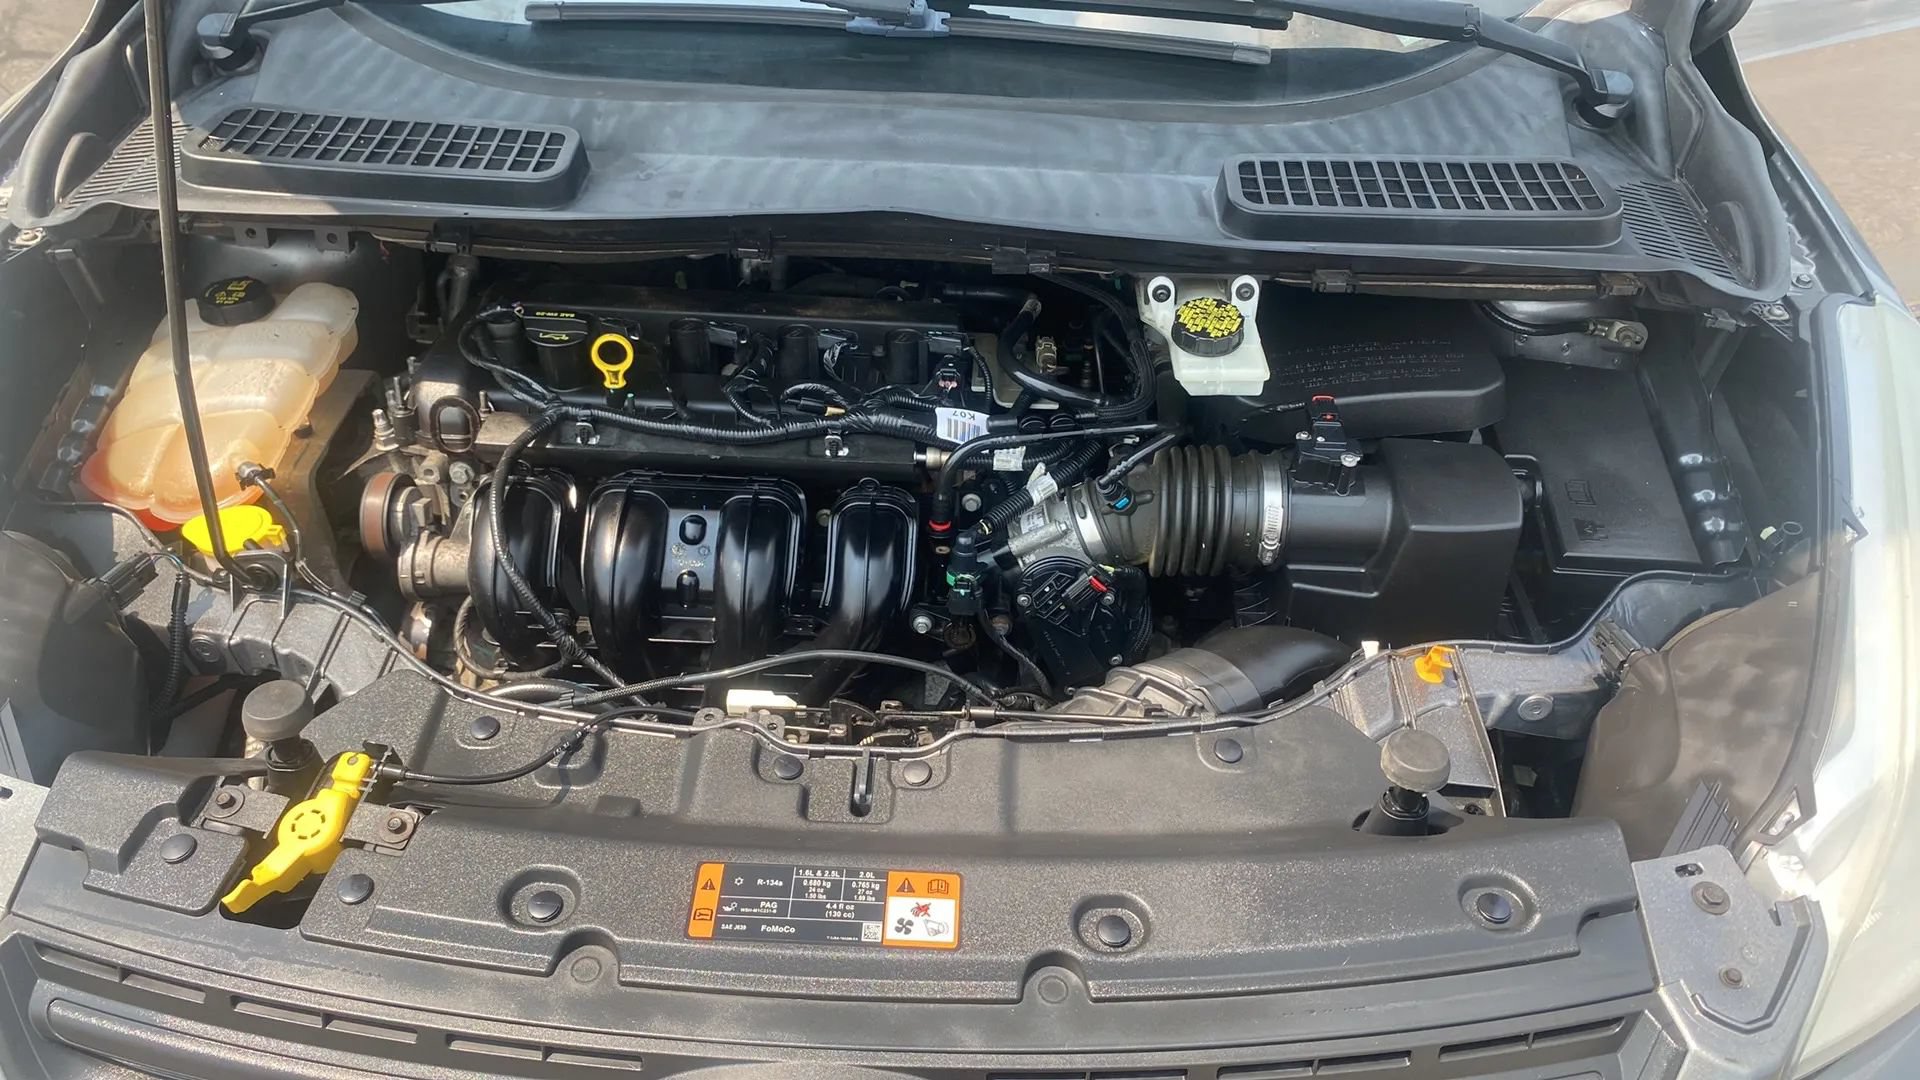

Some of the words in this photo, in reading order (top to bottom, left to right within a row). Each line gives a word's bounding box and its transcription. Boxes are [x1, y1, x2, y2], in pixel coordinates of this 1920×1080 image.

[952, 410, 976, 421] K07
[757, 878, 783, 886] R-134a
[822, 880, 831, 888] kg
[871, 882, 880, 890] kg
[760, 901, 778, 909] PAG
[825, 910, 841, 918] (130
[843, 911, 855, 919] cc)
[761, 925, 796, 933] FoMoCo
